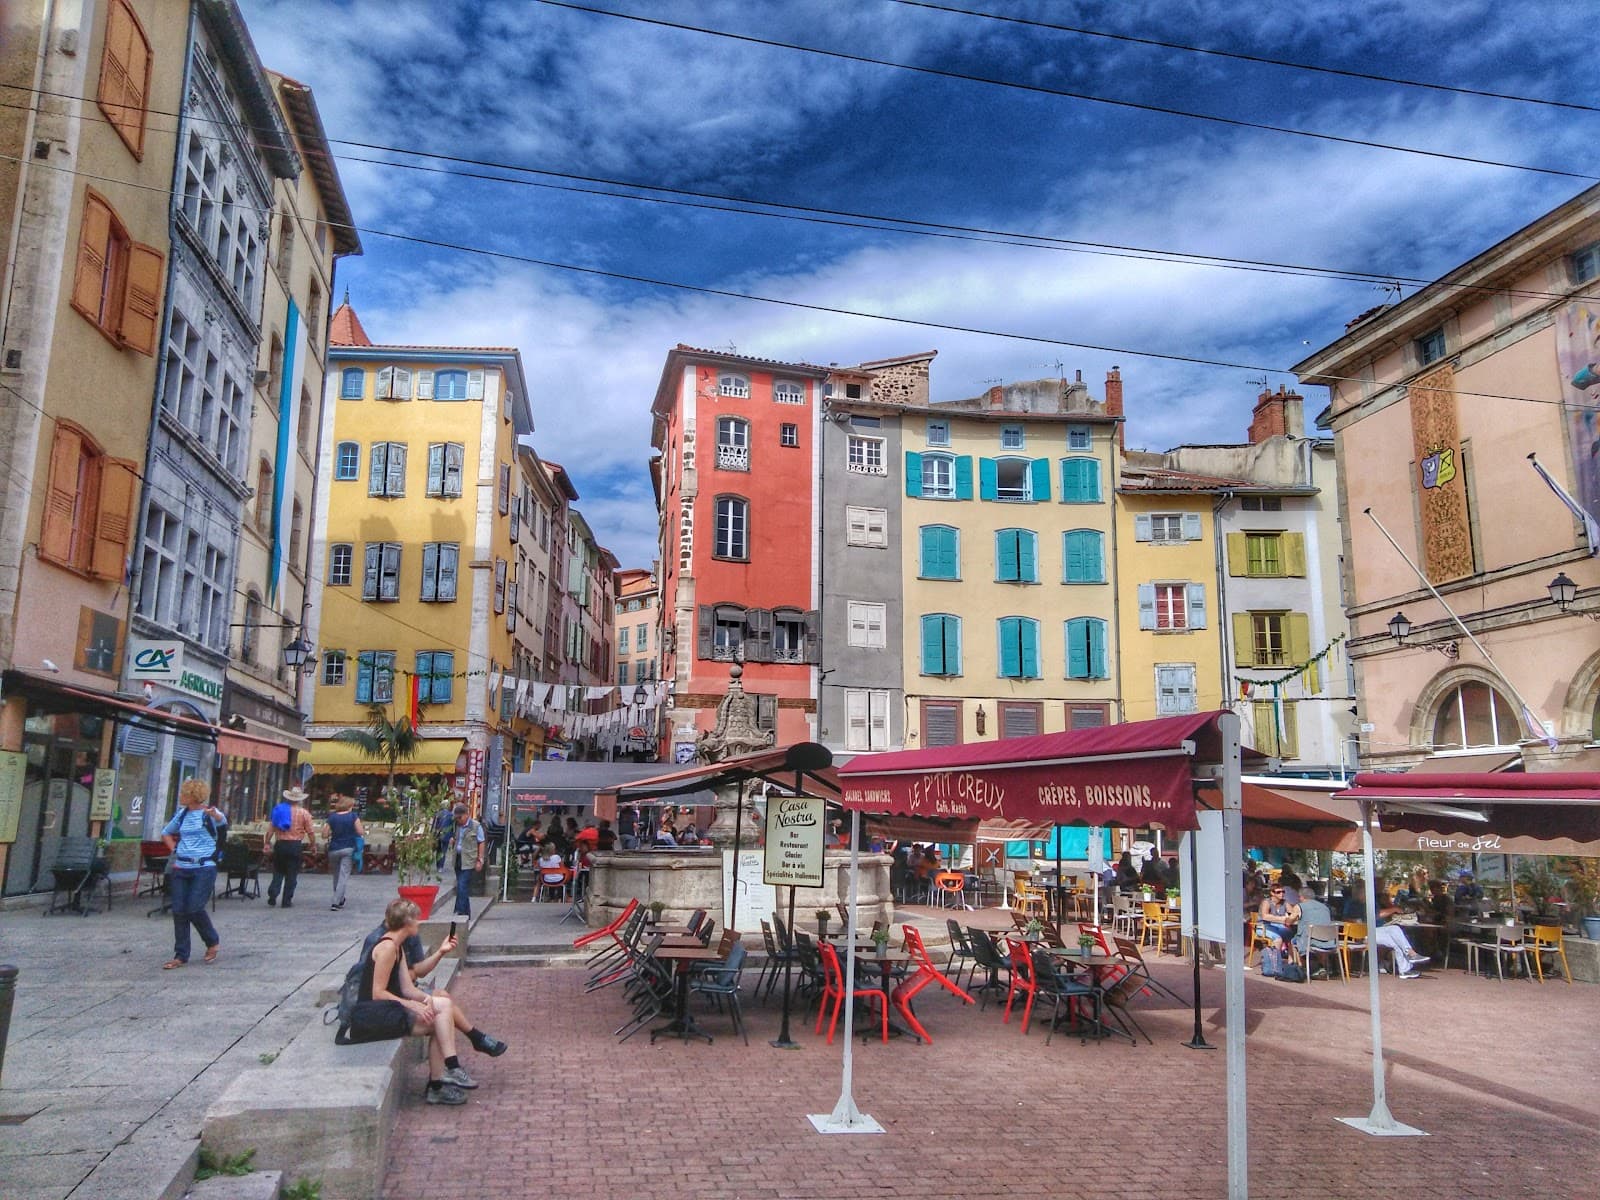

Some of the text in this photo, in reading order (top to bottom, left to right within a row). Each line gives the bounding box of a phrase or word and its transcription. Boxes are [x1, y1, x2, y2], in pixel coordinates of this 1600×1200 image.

[135, 648, 175, 668] CA
[179, 670, 223, 699] AGRICOLE
[909, 772, 1005, 816] LE P'TIT CREUX
[1038, 782, 1081, 809] CRÊPES,
[779, 799, 808, 814] Casa
[774, 812, 817, 830] Nostra
[790, 831, 799, 839] Bar
[780, 840, 809, 849] Restaurant
[1417, 836, 1456, 850] fleur
[1457, 841, 1470, 849] de
[784, 850, 803, 859] Glacier
[781, 860, 791, 869] Bar
